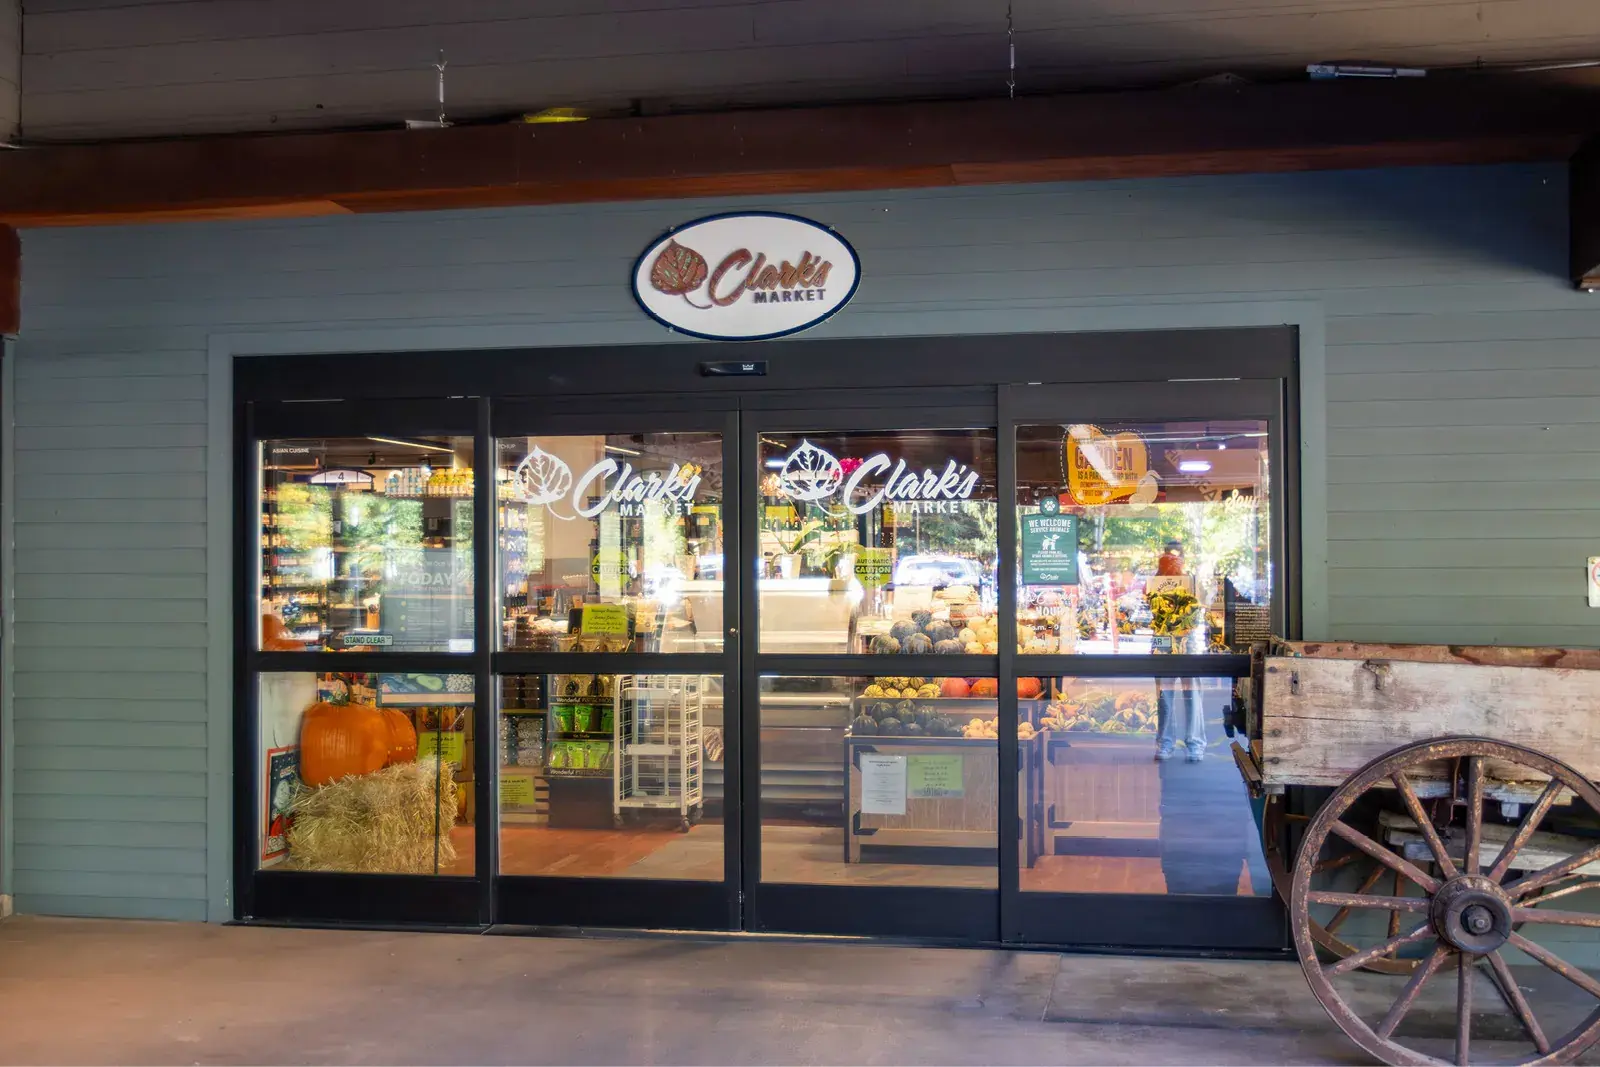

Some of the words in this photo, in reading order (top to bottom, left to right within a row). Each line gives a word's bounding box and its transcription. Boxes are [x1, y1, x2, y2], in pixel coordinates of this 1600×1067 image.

[708, 247, 834, 307] Clark's
[753, 288, 827, 304] MARKET
[1074, 445, 1133, 470] GADEN
[338, 471, 345, 482] 4
[572, 457, 702, 518] Clarks
[844, 453, 980, 515] Clark's
[620, 502, 695, 516] MAKET
[893, 500, 972, 514] MARKET
[1028, 519, 1039, 528] WE
[1039, 518, 1071, 528] WELCOME
[400, 572, 454, 586] TODAY
[1035, 606, 1067, 616] HOUR
[345, 636, 365, 644] STAND
[366, 636, 386, 644] CLEAR
